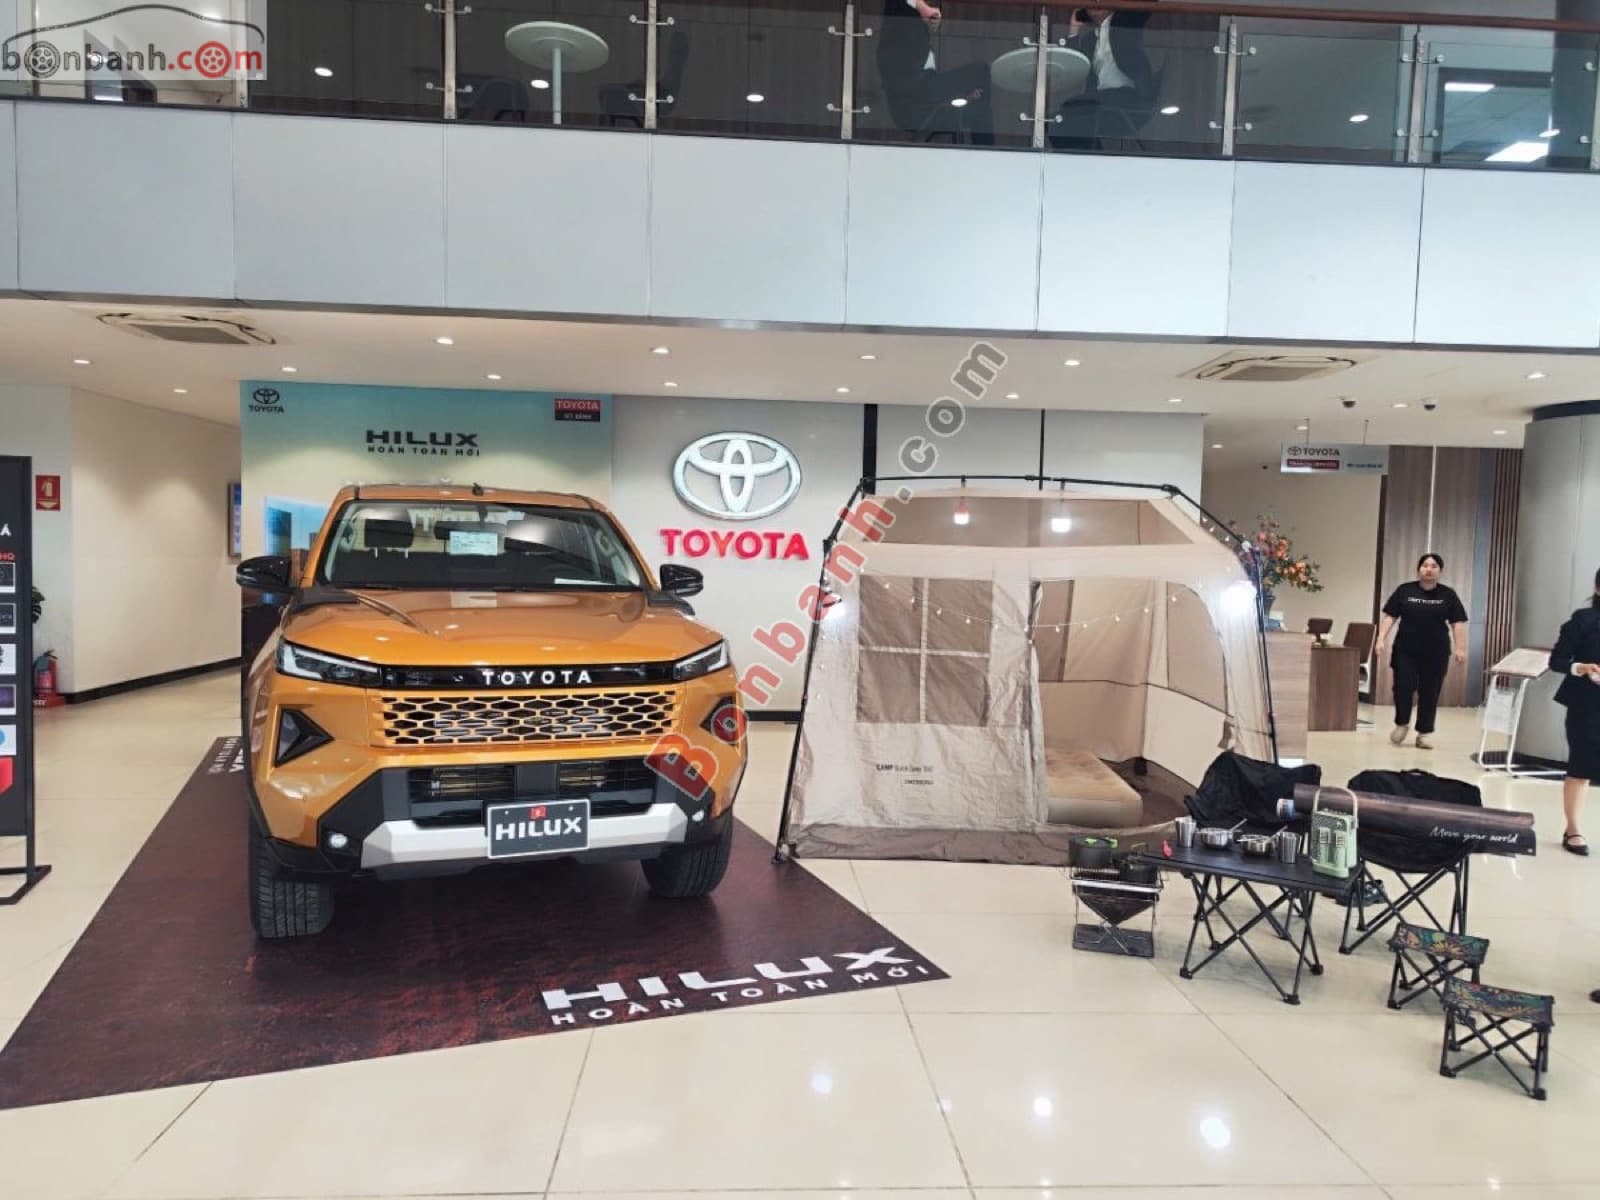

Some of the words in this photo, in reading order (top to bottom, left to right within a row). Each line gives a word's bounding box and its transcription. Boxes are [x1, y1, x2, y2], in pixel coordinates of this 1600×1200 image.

[556, 399, 600, 410] TOYOTA
[366, 430, 479, 447] HILUX
[1303, 447, 1340, 456] TOYOTA
[659, 528, 809, 560] TOYOTA
[481, 669, 593, 686] TOYOTA
[495, 816, 582, 841] HILUX
[1462, 832, 1487, 843] your
[1489, 833, 1519, 844] world
[541, 947, 914, 1010] HILUX
[550, 998, 686, 1026] HOÀN
[711, 978, 829, 1002] TOÀN
